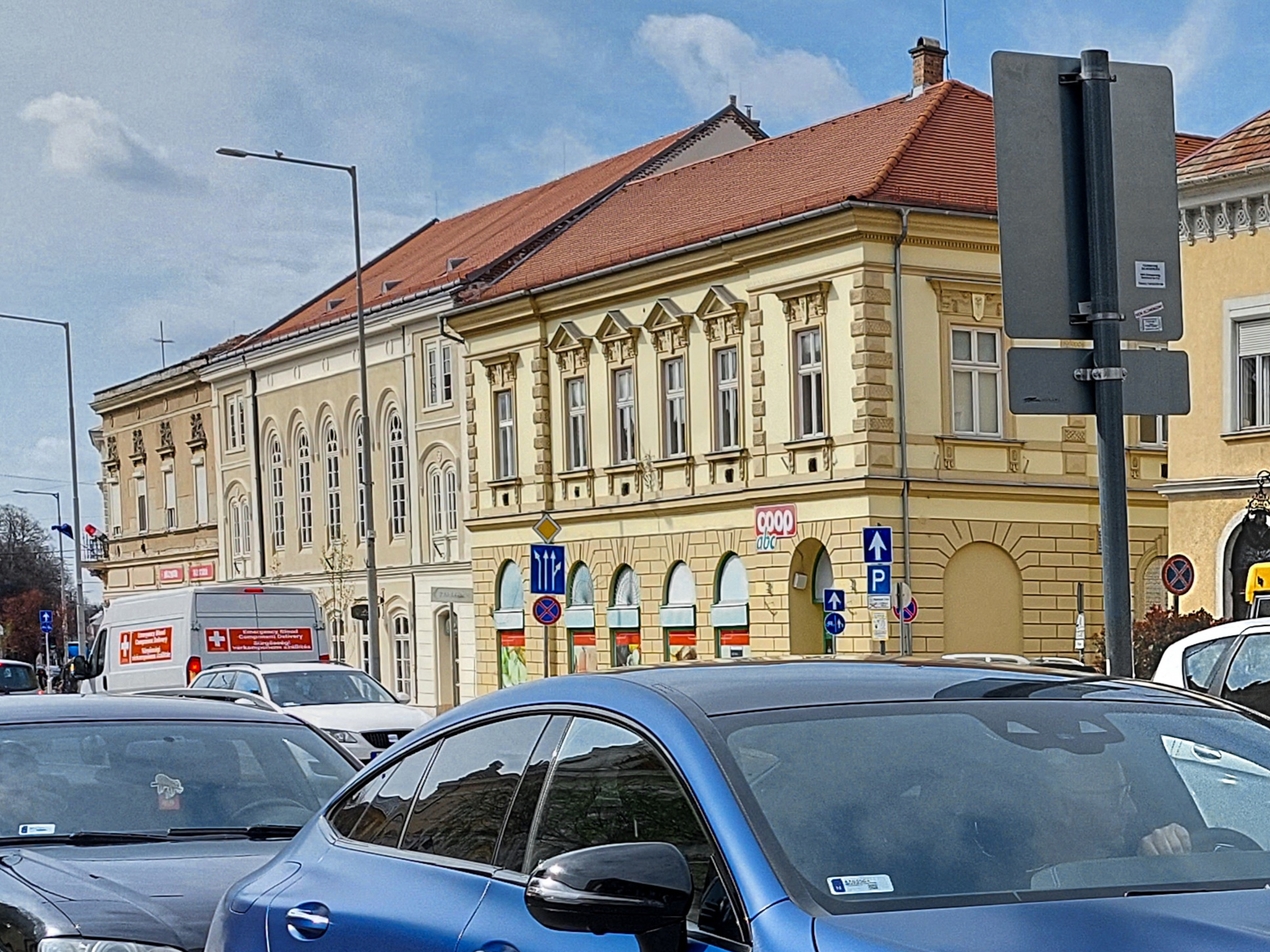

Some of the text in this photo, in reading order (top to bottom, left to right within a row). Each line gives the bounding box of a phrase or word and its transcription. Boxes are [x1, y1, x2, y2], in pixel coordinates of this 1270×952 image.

[757, 510, 794, 536] coop
[756, 527, 777, 550] abc
[872, 568, 886, 592] P
